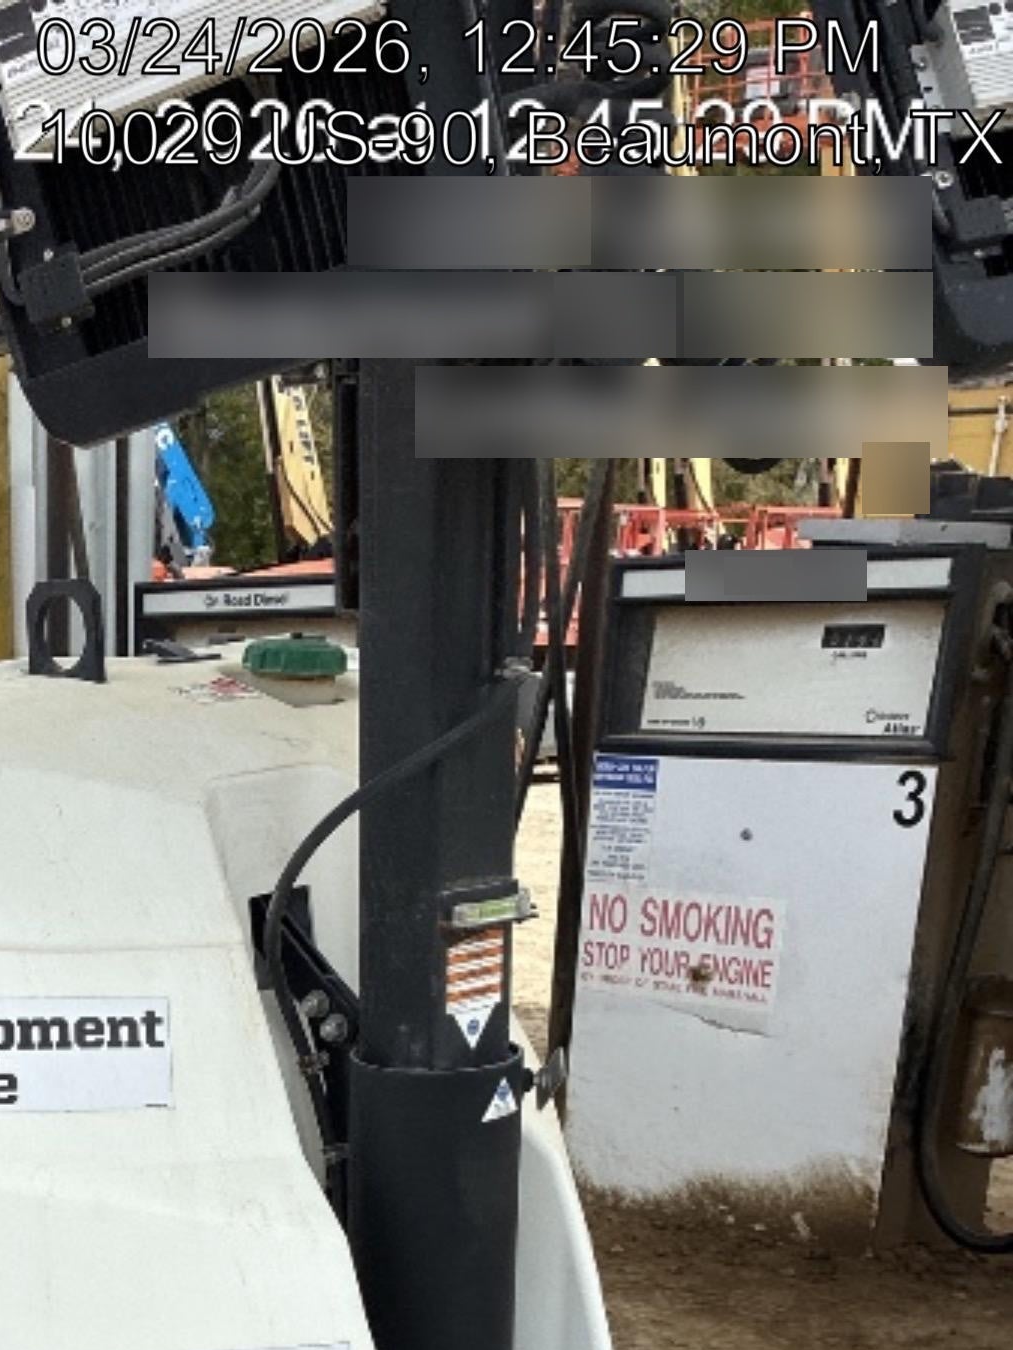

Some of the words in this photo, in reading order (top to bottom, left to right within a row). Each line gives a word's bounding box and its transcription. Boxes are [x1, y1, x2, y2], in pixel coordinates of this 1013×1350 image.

[893, 769, 927, 829] 3
[588, 892, 629, 935] NO
[640, 895, 775, 950] SMOKING
[582, 939, 631, 970] STOP
[640, 946, 691, 980] YOUR
[698, 952, 775, 989] ENGINE
